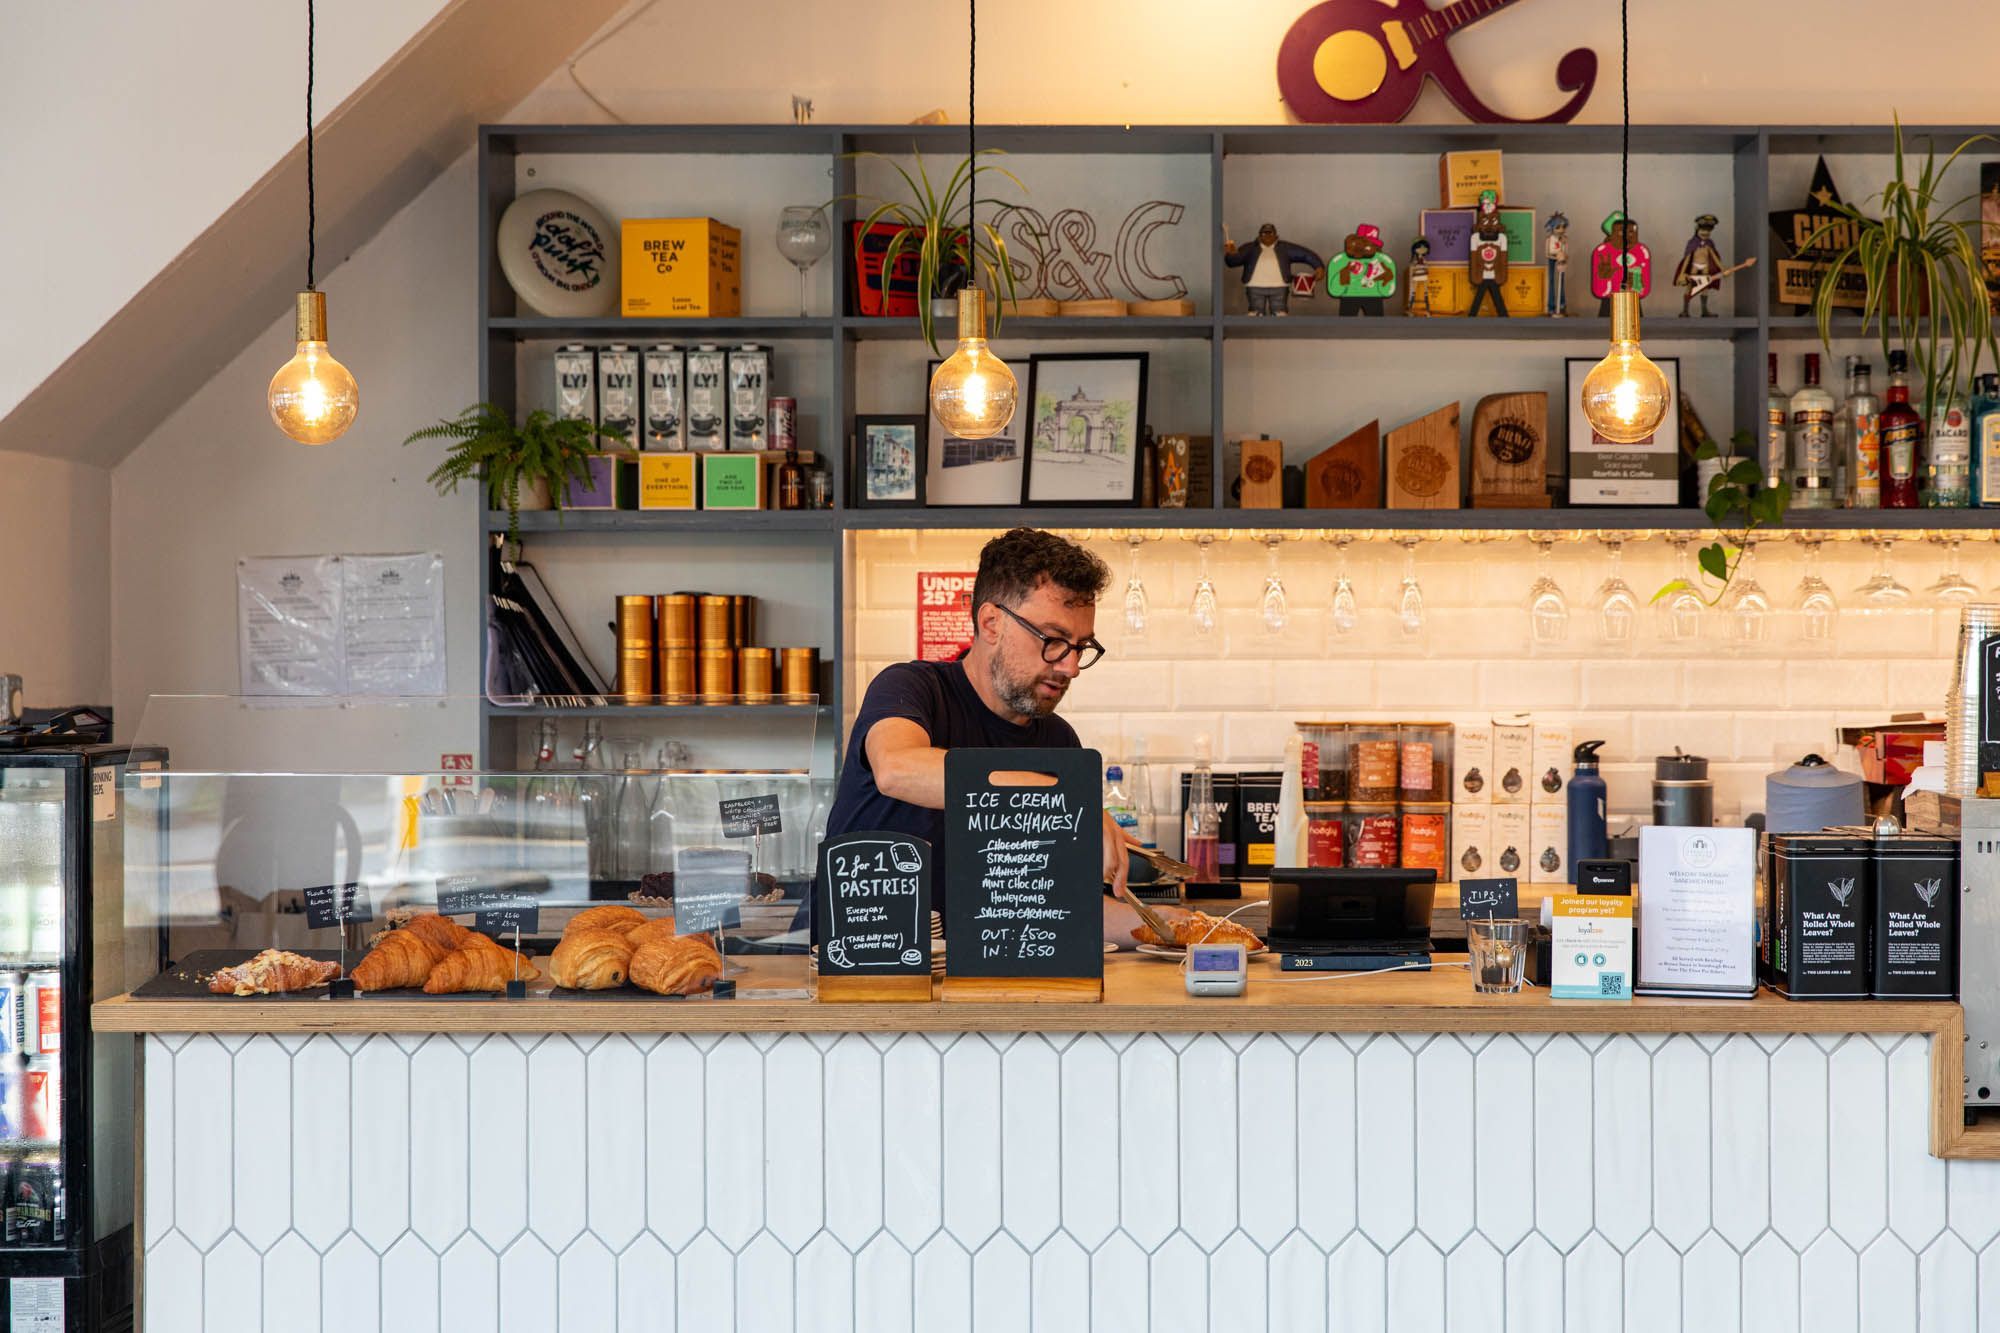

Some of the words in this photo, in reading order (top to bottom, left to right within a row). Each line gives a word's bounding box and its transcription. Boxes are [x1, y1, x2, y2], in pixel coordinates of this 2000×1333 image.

[643, 239, 685, 251] BREW
[651, 251, 678, 262] TEA
[656, 263, 673, 274] Co
[563, 373, 588, 388] LY!
[607, 373, 633, 388] LY!
[693, 373, 719, 388] LY!
[1592, 470, 1622, 478] Starfish
[1630, 470, 1654, 478] Coffee
[922, 576, 975, 591] UNDE
[922, 591, 956, 605] 25?
[965, 792, 1000, 808] ICE
[1009, 792, 1067, 813] CREAM
[968, 807, 1084, 841] MILKSHAKES!
[1258, 822, 1274, 833] Co
[986, 838, 1040, 852] CHOCOLATE
[836, 857, 849, 876] 2
[850, 854, 870, 879] for
[873, 851, 888, 872] 1
[986, 853, 1049, 869] STRAWBERRY
[988, 864, 1028, 877] VANILLA
[840, 877, 916, 898] PASTRIES
[982, 879, 1005, 889] MINT
[1007, 875, 1030, 889] CHOC
[1031, 877, 1054, 891] CHIP
[991, 892, 1046, 907] HONEYCOMB
[1471, 890, 1495, 901] TIPS
[1560, 898, 1584, 906] Joined
[1599, 899, 1623, 907] loyalty
[979, 906, 1015, 920] SALTED
[1016, 907, 1066, 920] CARAMEL
[1569, 907, 1598, 915] program
[1600, 907, 1615, 915] yet?
[1803, 912, 1824, 920] What
[1826, 912, 1841, 920] Are
[1888, 912, 1910, 920] What
[1912, 912, 1926, 920] Are
[847, 915, 869, 923] AFTER
[1803, 920, 1828, 928] Rolled
[1830, 920, 1855, 928] Whole
[1888, 920, 1914, 928] Rolled
[1915, 920, 1940, 928] Whole
[883, 933, 899, 941] ONLY
[981, 928, 1015, 941] OUT:
[1803, 929, 1834, 937] Leaves?
[1888, 929, 1919, 937] Leaves?
[983, 945, 1008, 958] IN:
[1295, 959, 1313, 967] 2023
[16, 994, 25, 1044] BRIGHTON
